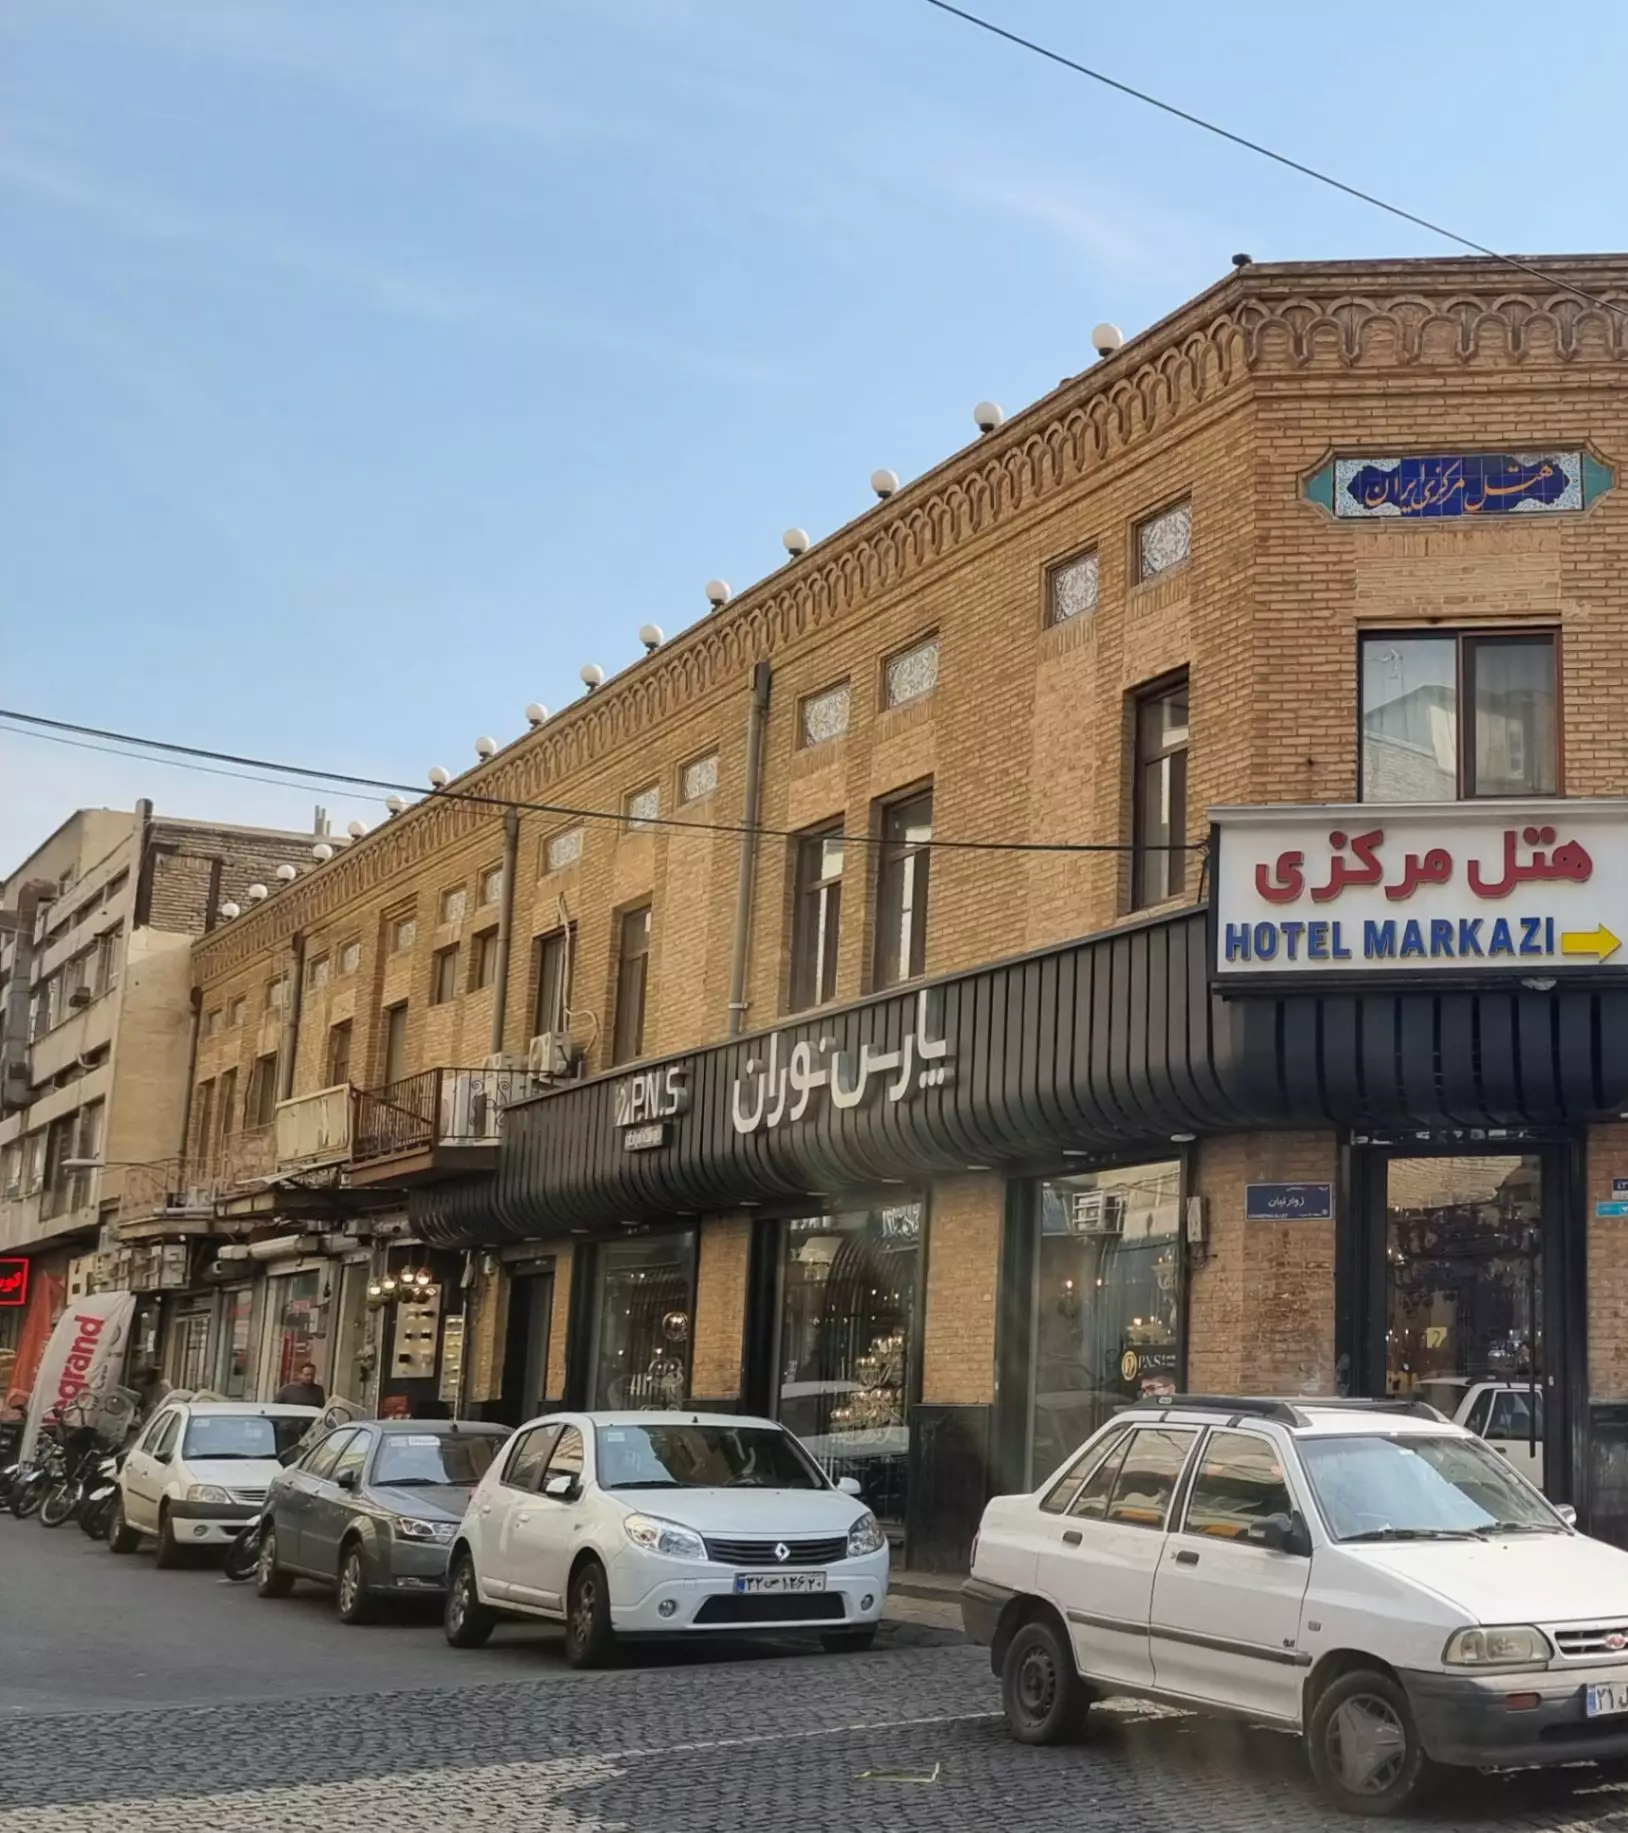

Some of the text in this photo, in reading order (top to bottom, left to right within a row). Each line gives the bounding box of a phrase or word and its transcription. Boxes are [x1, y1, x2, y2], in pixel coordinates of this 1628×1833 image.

[1365, 458, 1553, 513] هتل مرکزی ایران
[1254, 826, 1594, 904] هتل مرکزی
[1225, 916, 1556, 962] HOTEL MARKAZI
[830, 988, 951, 1110] پارس
